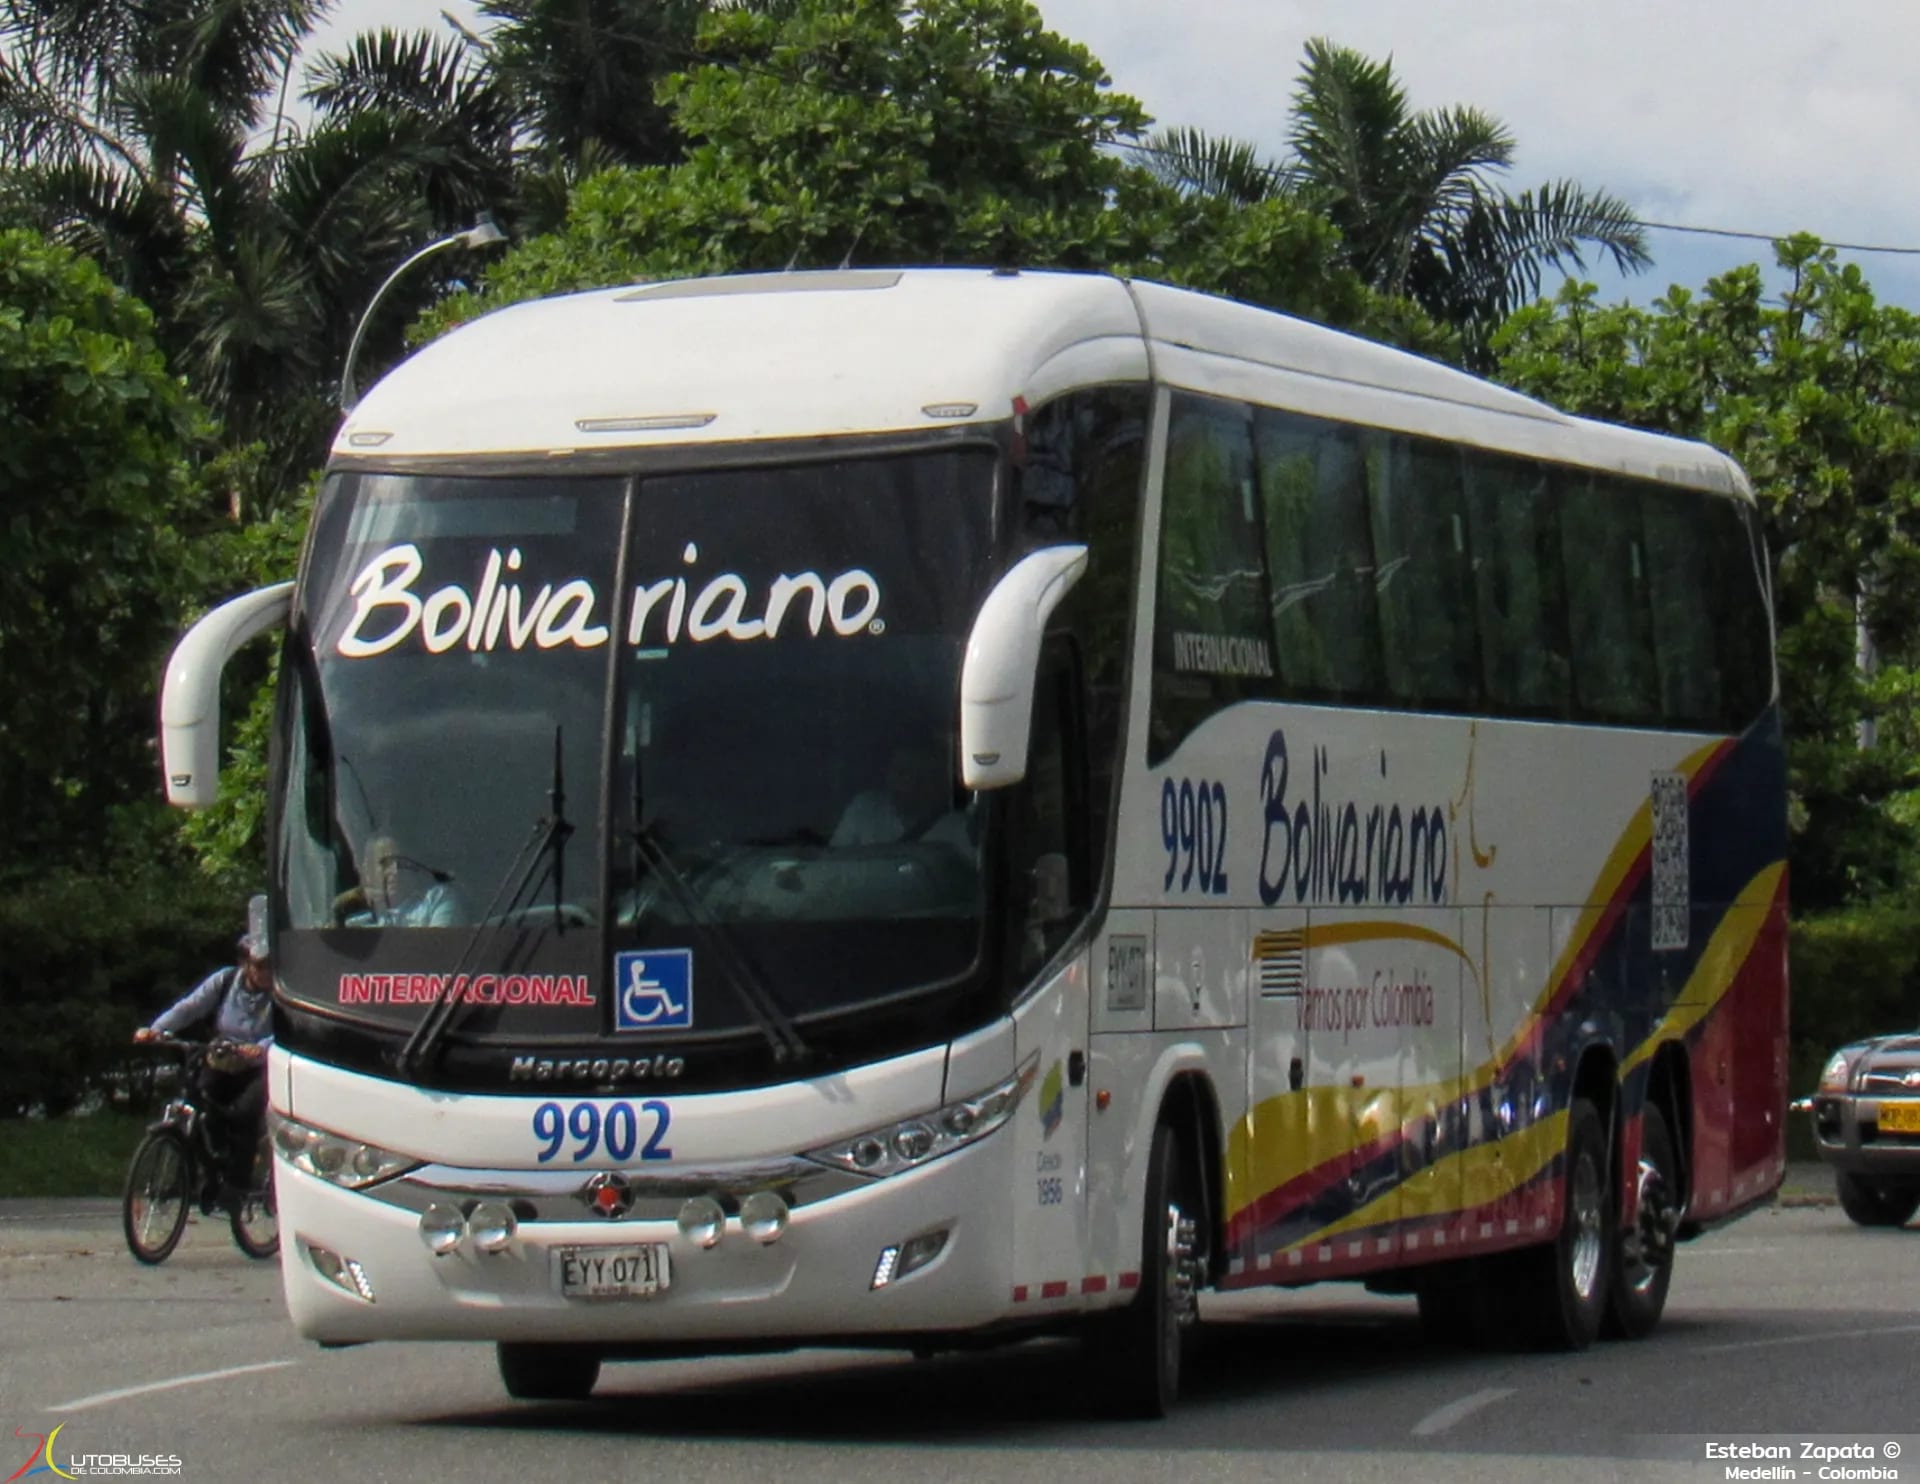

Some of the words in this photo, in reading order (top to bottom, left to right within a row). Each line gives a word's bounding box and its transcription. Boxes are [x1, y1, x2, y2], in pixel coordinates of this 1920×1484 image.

[1174, 631, 1274, 678] INTERNACIONAL
[1161, 777, 1228, 895] 9902
[1259, 729, 1447, 906] Bolivariano
[338, 973, 597, 1005] INTERNACIONAL
[1343, 986, 1369, 1046] por
[1372, 968, 1434, 1028] Colombia
[509, 1055, 685, 1083] Marcopolo
[532, 1100, 673, 1163] 9902
